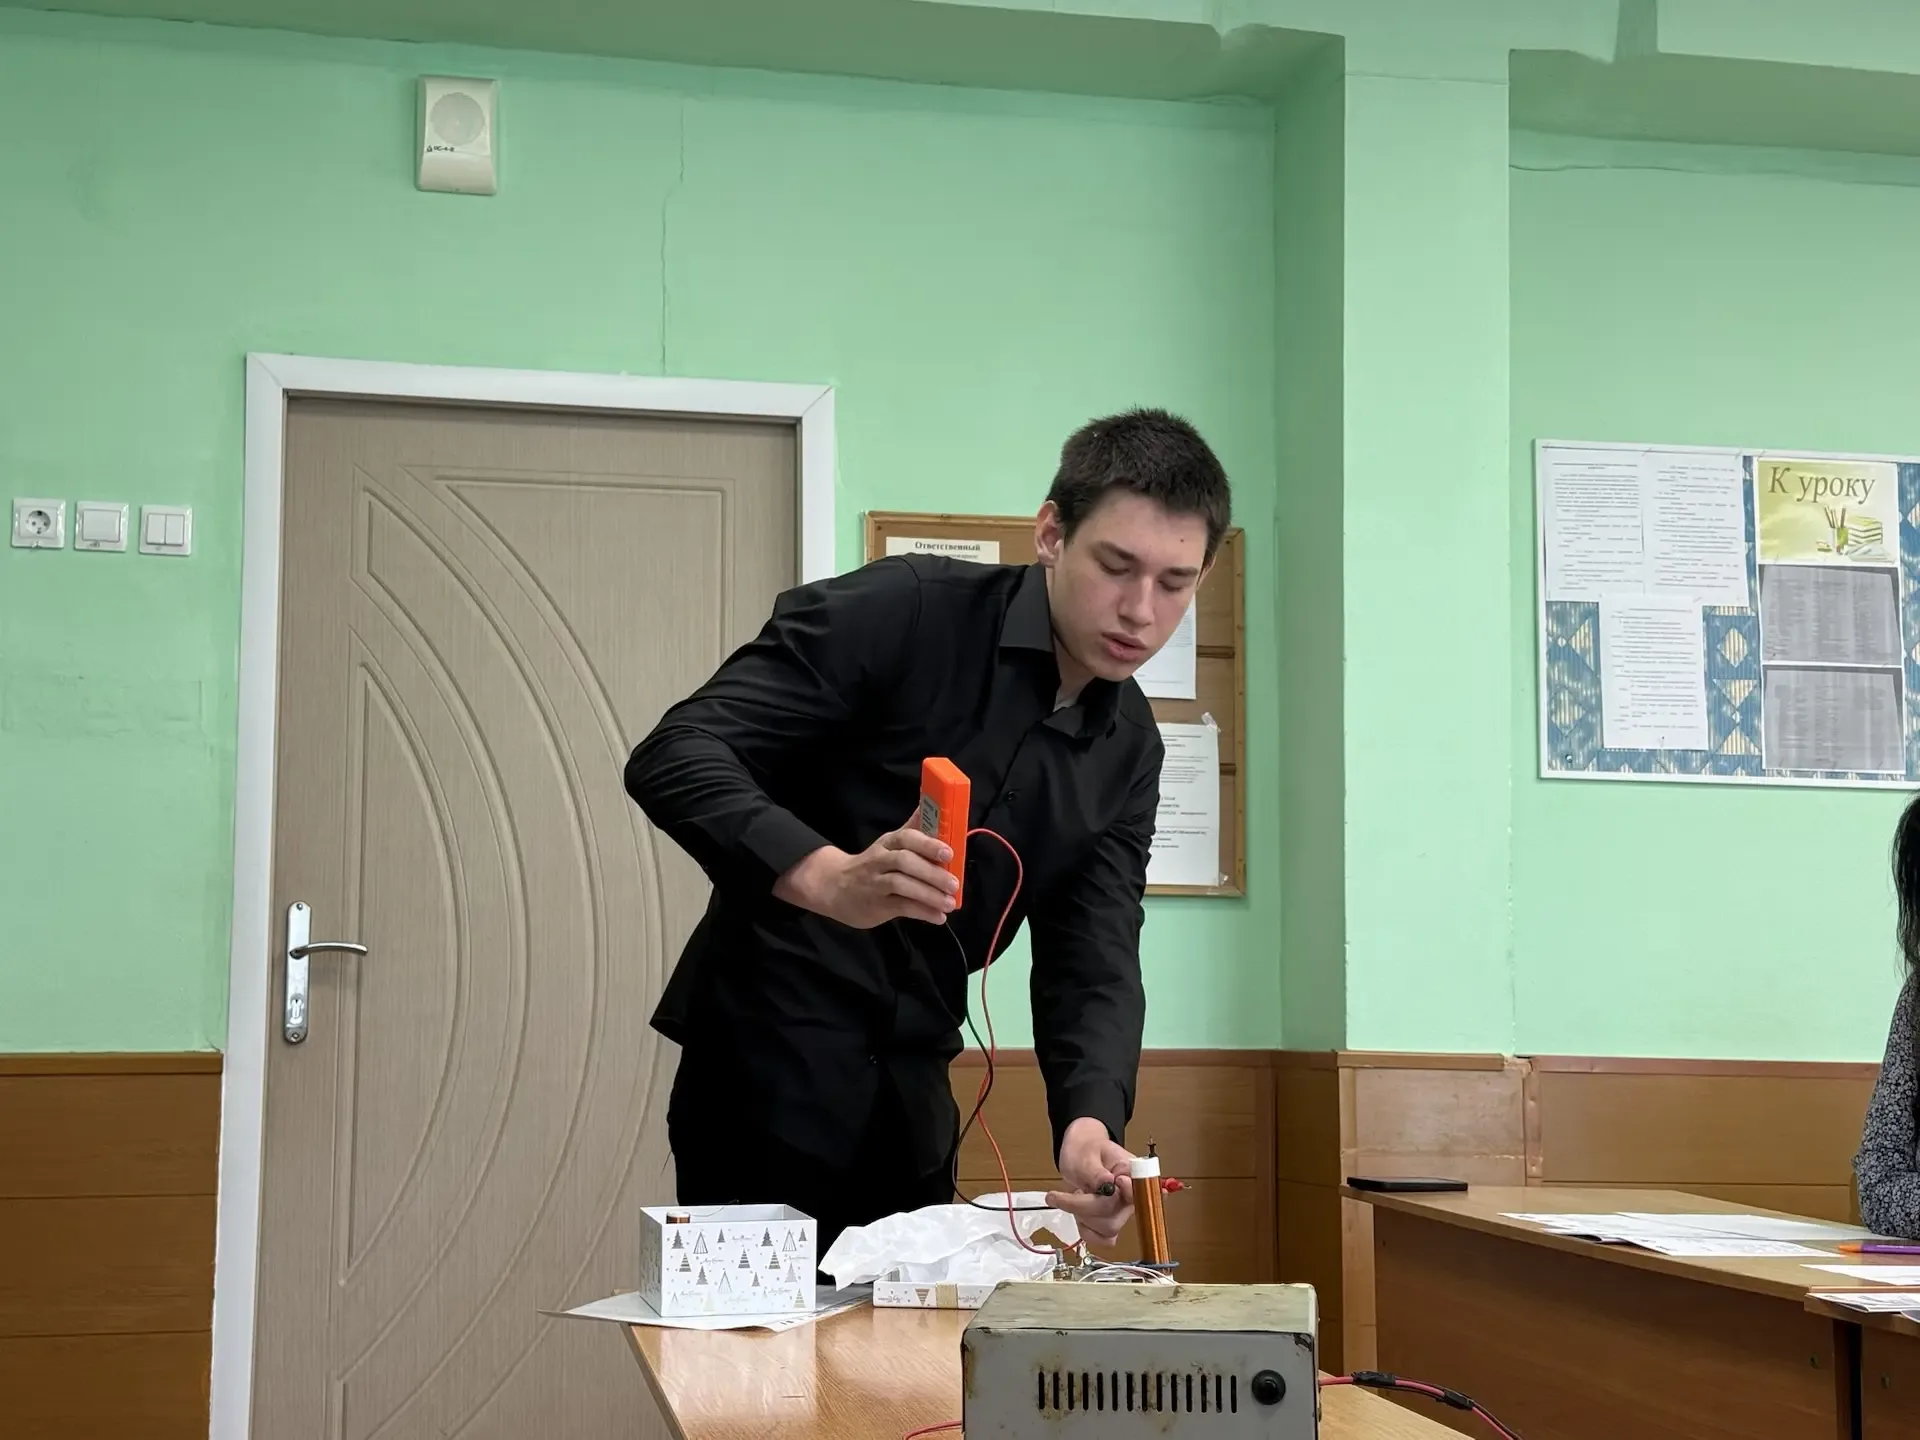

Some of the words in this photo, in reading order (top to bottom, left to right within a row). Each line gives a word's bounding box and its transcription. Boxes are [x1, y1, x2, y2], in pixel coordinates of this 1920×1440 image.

[1768, 466, 1791, 493] К
[1796, 476, 1876, 505] уроку
[915, 541, 981, 551] Ответственный
